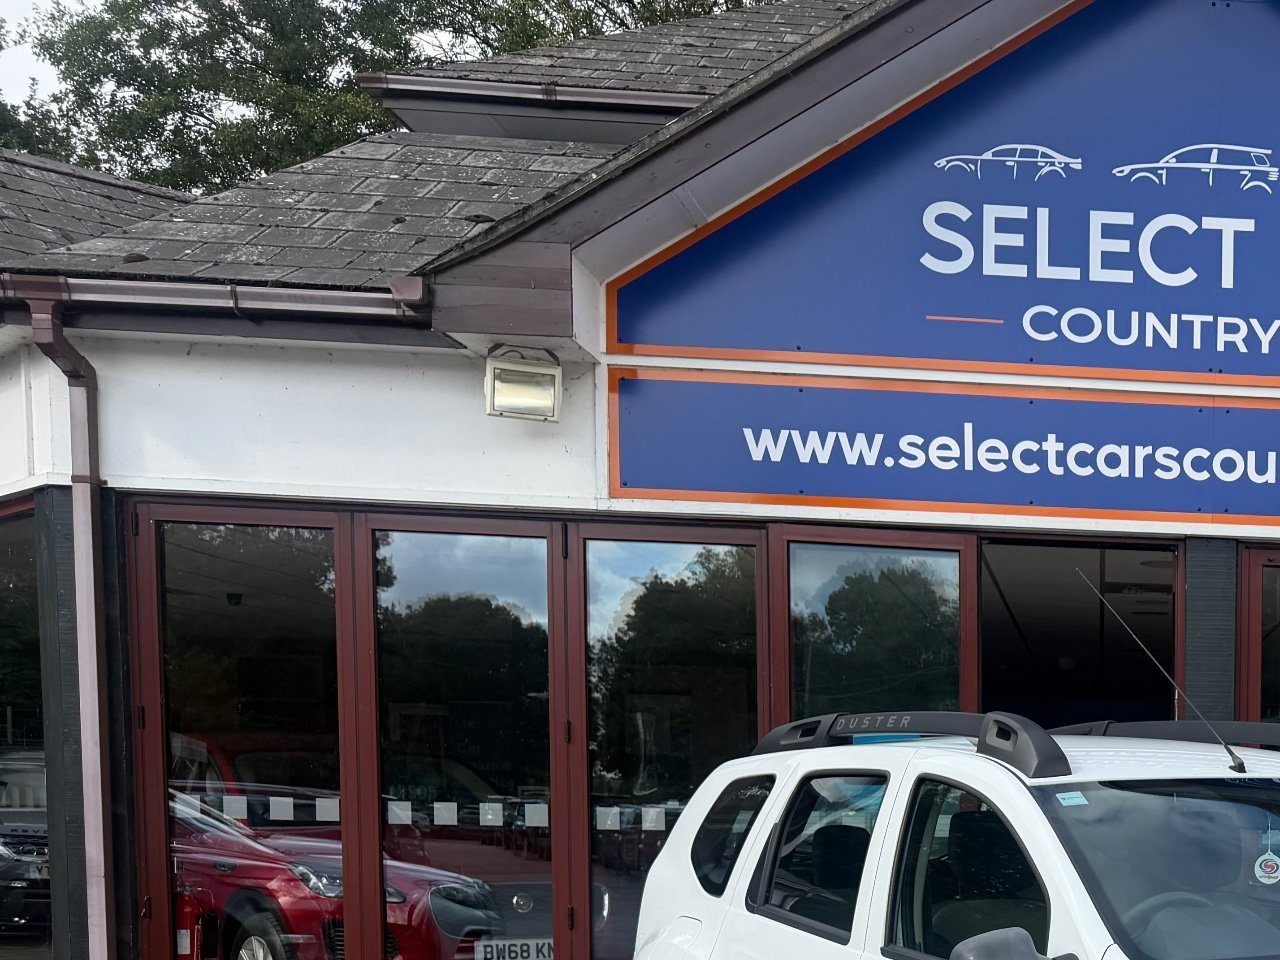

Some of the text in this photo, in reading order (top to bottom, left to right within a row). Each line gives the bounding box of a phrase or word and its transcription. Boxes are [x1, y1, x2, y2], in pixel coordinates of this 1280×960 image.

[920, 201, 1254, 289] SELECT
[836, 715, 911, 730] DUSTER
[483, 942, 554, 960] BW68 KN
